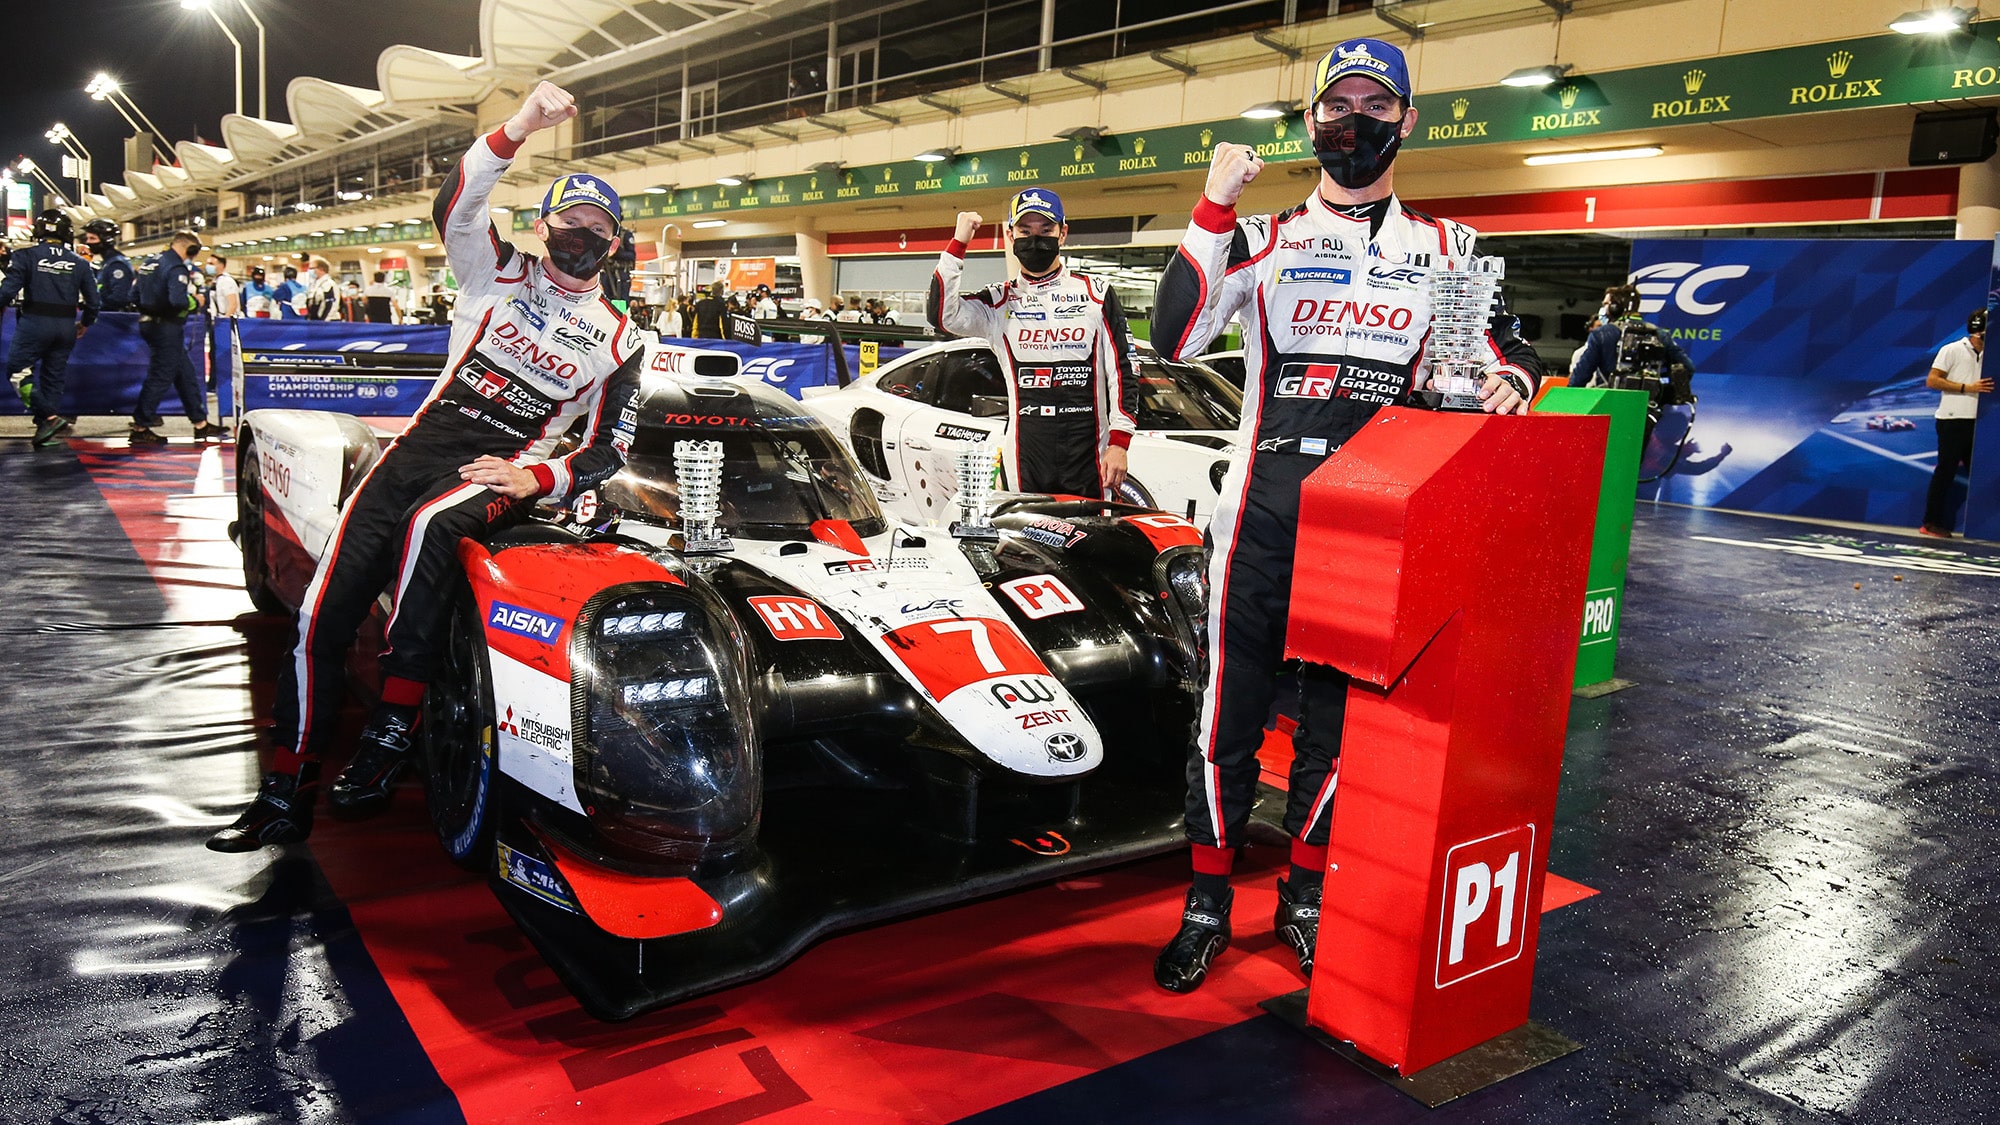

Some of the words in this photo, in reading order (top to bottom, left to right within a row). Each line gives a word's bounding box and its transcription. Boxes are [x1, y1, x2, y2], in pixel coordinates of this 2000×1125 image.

[1327, 58, 1390, 80] MICHELIN
[1951, 66, 2000, 89] RO
[1790, 78, 1882, 105] ROLEX
[1651, 95, 1731, 119] ROLEX
[1531, 109, 1601, 131] ROLEX
[1427, 121, 1488, 141] ROLEX
[1183, 150, 1216, 164] ROLE
[1257, 140, 1303, 156] ROLEX
[1060, 162, 1095, 176] ROLEX
[1119, 156, 1157, 171] ROLEX
[915, 178, 942, 190] ROLEX
[960, 173, 989, 186] ROLEX
[1007, 169, 1039, 181] ROLEX
[802, 191, 824, 201] ROLEX
[837, 187, 860, 197] ROLEX
[875, 183, 899, 194] ROLEX
[713, 200, 730, 209] ROLEX
[740, 197, 759, 206] ROLEX
[770, 194, 790, 204] ROLEX
[1583, 197, 1596, 224] 1
[731, 242, 738, 255] 4
[898, 233, 907, 249] 3
[1280, 238, 1315, 250] ZENT
[50, 247, 63, 256] TV
[38, 258, 76, 271] WEC
[1294, 271, 1345, 281] MICHELIN
[1368, 266, 1425, 284] WEC
[1052, 293, 1079, 303] Mobil
[1627, 262, 1750, 315] EC
[1054, 305, 1087, 313] WEC
[1291, 299, 1413, 331] DENSO
[559, 308, 594, 334] Mobil
[734, 319, 755, 336] BOSS
[554, 327, 598, 351] WEC
[1018, 327, 1086, 342] DENSO
[1291, 325, 1342, 337] TOYOTA
[1348, 329, 1410, 346] HYBRID
[488, 334, 522, 363] TOYOTA
[494, 321, 578, 380] DENSO
[863, 345, 875, 354] one
[650, 351, 686, 374] ZENT
[741, 357, 795, 382] EC
[333, 376, 398, 384] ENDURANCE
[460, 367, 502, 398] GR
[1019, 375, 1050, 387] GR
[1339, 376, 1400, 395] GAZOO
[1346, 365, 1405, 386] TOYOTA
[268, 383, 355, 391] CHAMPIONSHIP
[1278, 376, 1333, 397] GR
[1335, 387, 1395, 406] Racing
[502, 392, 546, 416] GAZOO
[510, 383, 553, 411] TOYOTA
[263, 451, 291, 498] DENSO
[485, 496, 512, 524] DEN
[1022, 526, 1066, 547] HYBRID
[1029, 519, 1076, 535] TOYOTA
[1065, 530, 1087, 549] 7
[827, 561, 877, 576] GR
[1014, 580, 1071, 611] P1
[757, 601, 825, 632] HY
[901, 599, 964, 614] WEC
[1583, 596, 1614, 637] PRO
[492, 607, 557, 639] AISIN
[929, 620, 1007, 674] 7
[520, 717, 571, 741] MITSUBISHI
[1015, 709, 1073, 730] ZENT
[520, 729, 562, 751] ELECTRIC
[1449, 851, 1520, 966] P1
